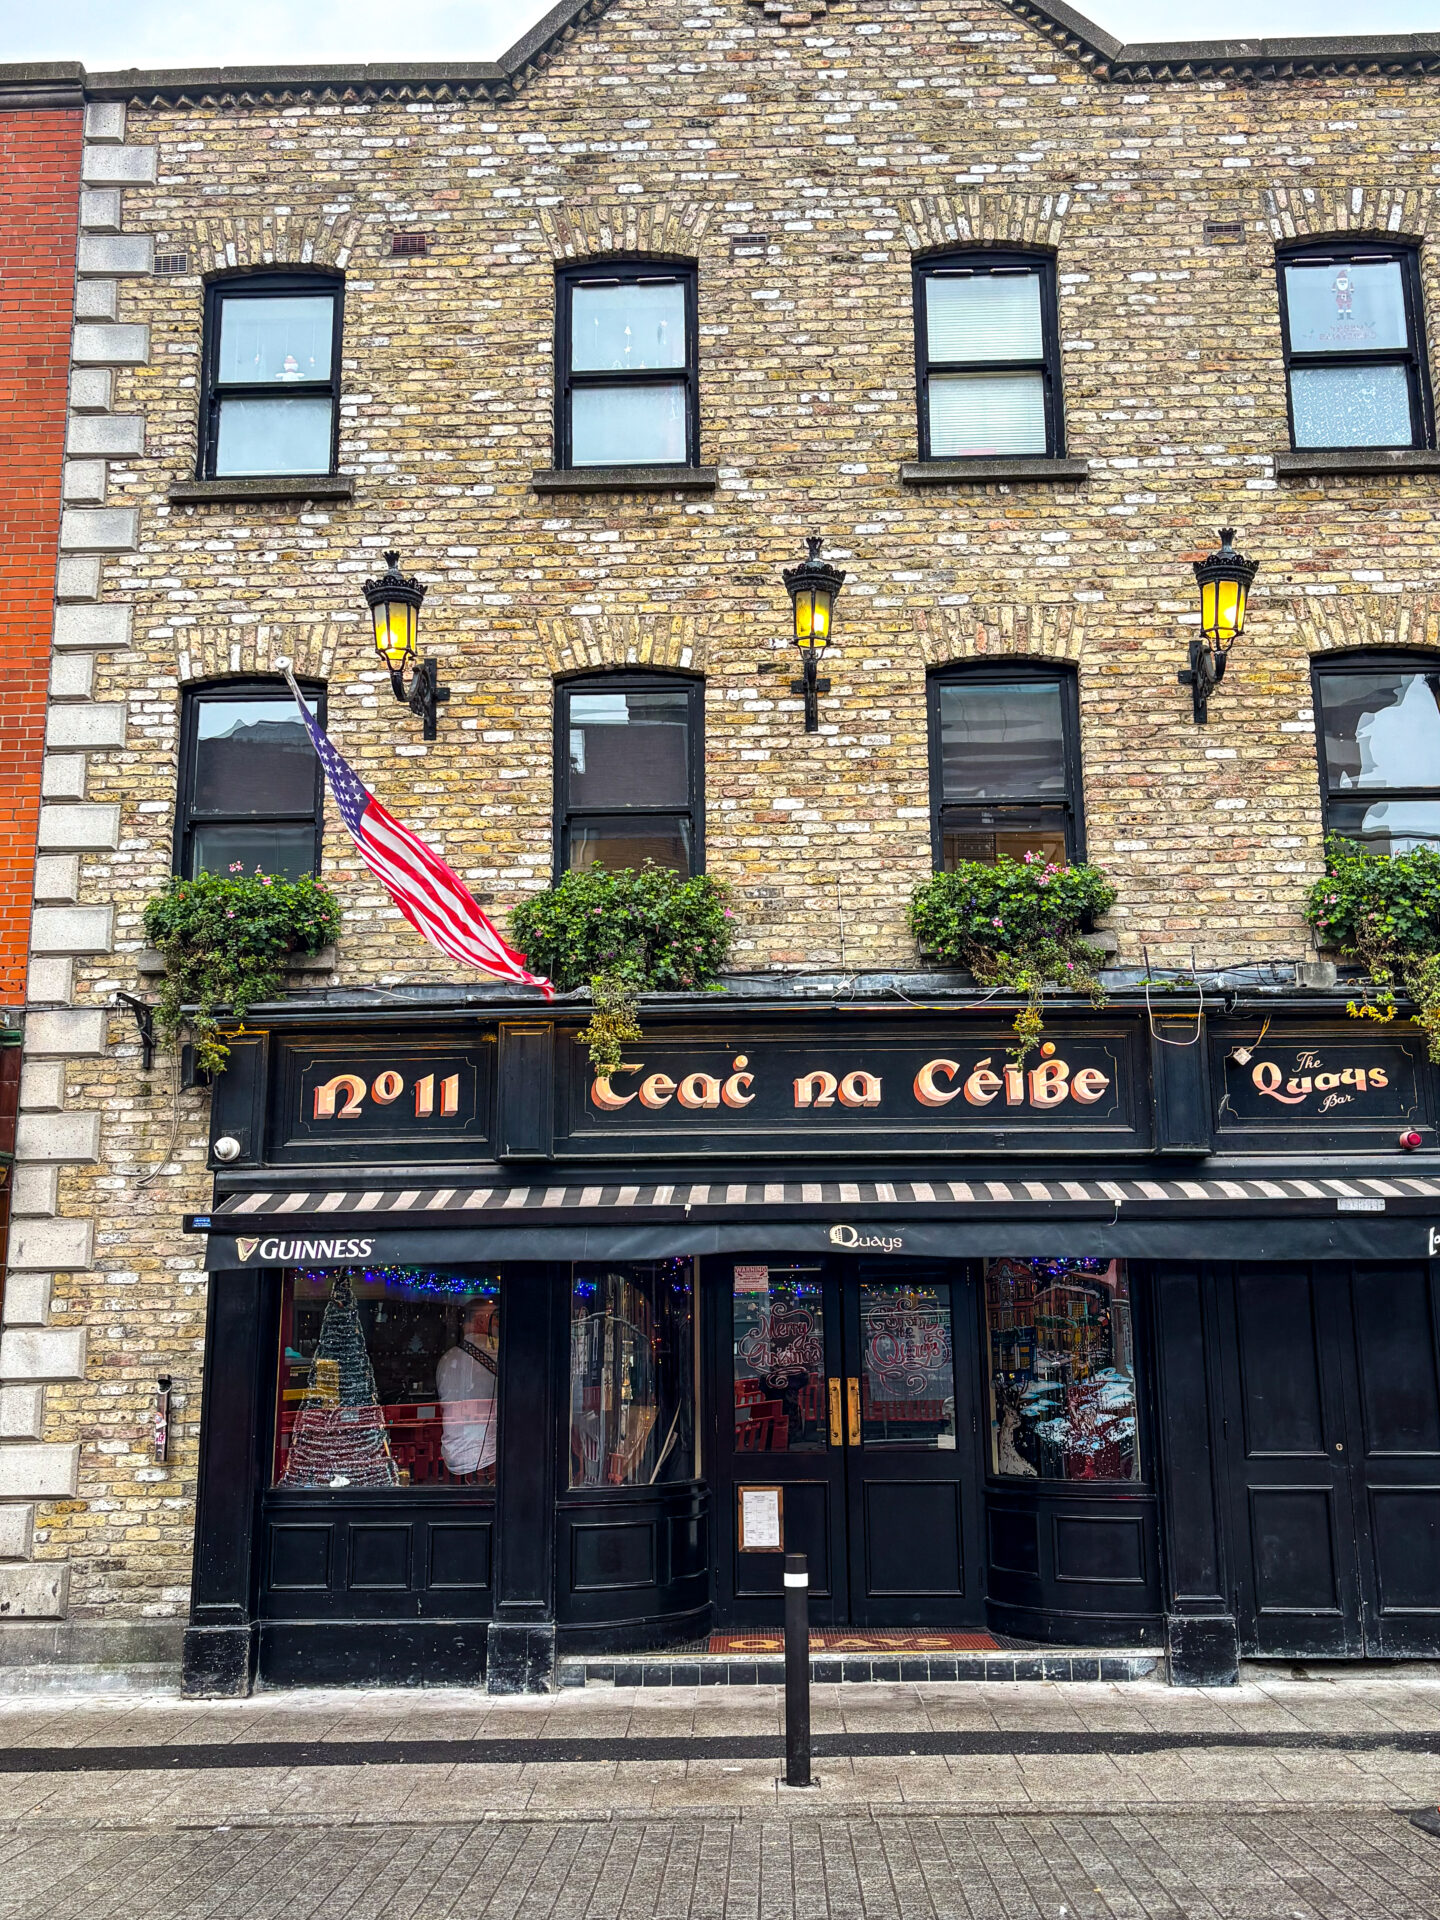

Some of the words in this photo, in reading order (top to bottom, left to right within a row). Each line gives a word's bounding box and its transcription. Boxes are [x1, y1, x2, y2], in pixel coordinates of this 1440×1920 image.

[1291, 1050, 1324, 1073] The
[414, 1073, 459, 1117] 11
[793, 1070, 883, 1108] na
[1251, 1061, 1389, 1105] Quays
[1317, 1092, 1355, 1113] Bar
[259, 1238, 373, 1260] GUINNESS
[829, 1224, 903, 1253] Quays
[748, 1310, 813, 1349] Merry
[746, 1340, 822, 1368] Christmas
[871, 1331, 942, 1368] Quays
